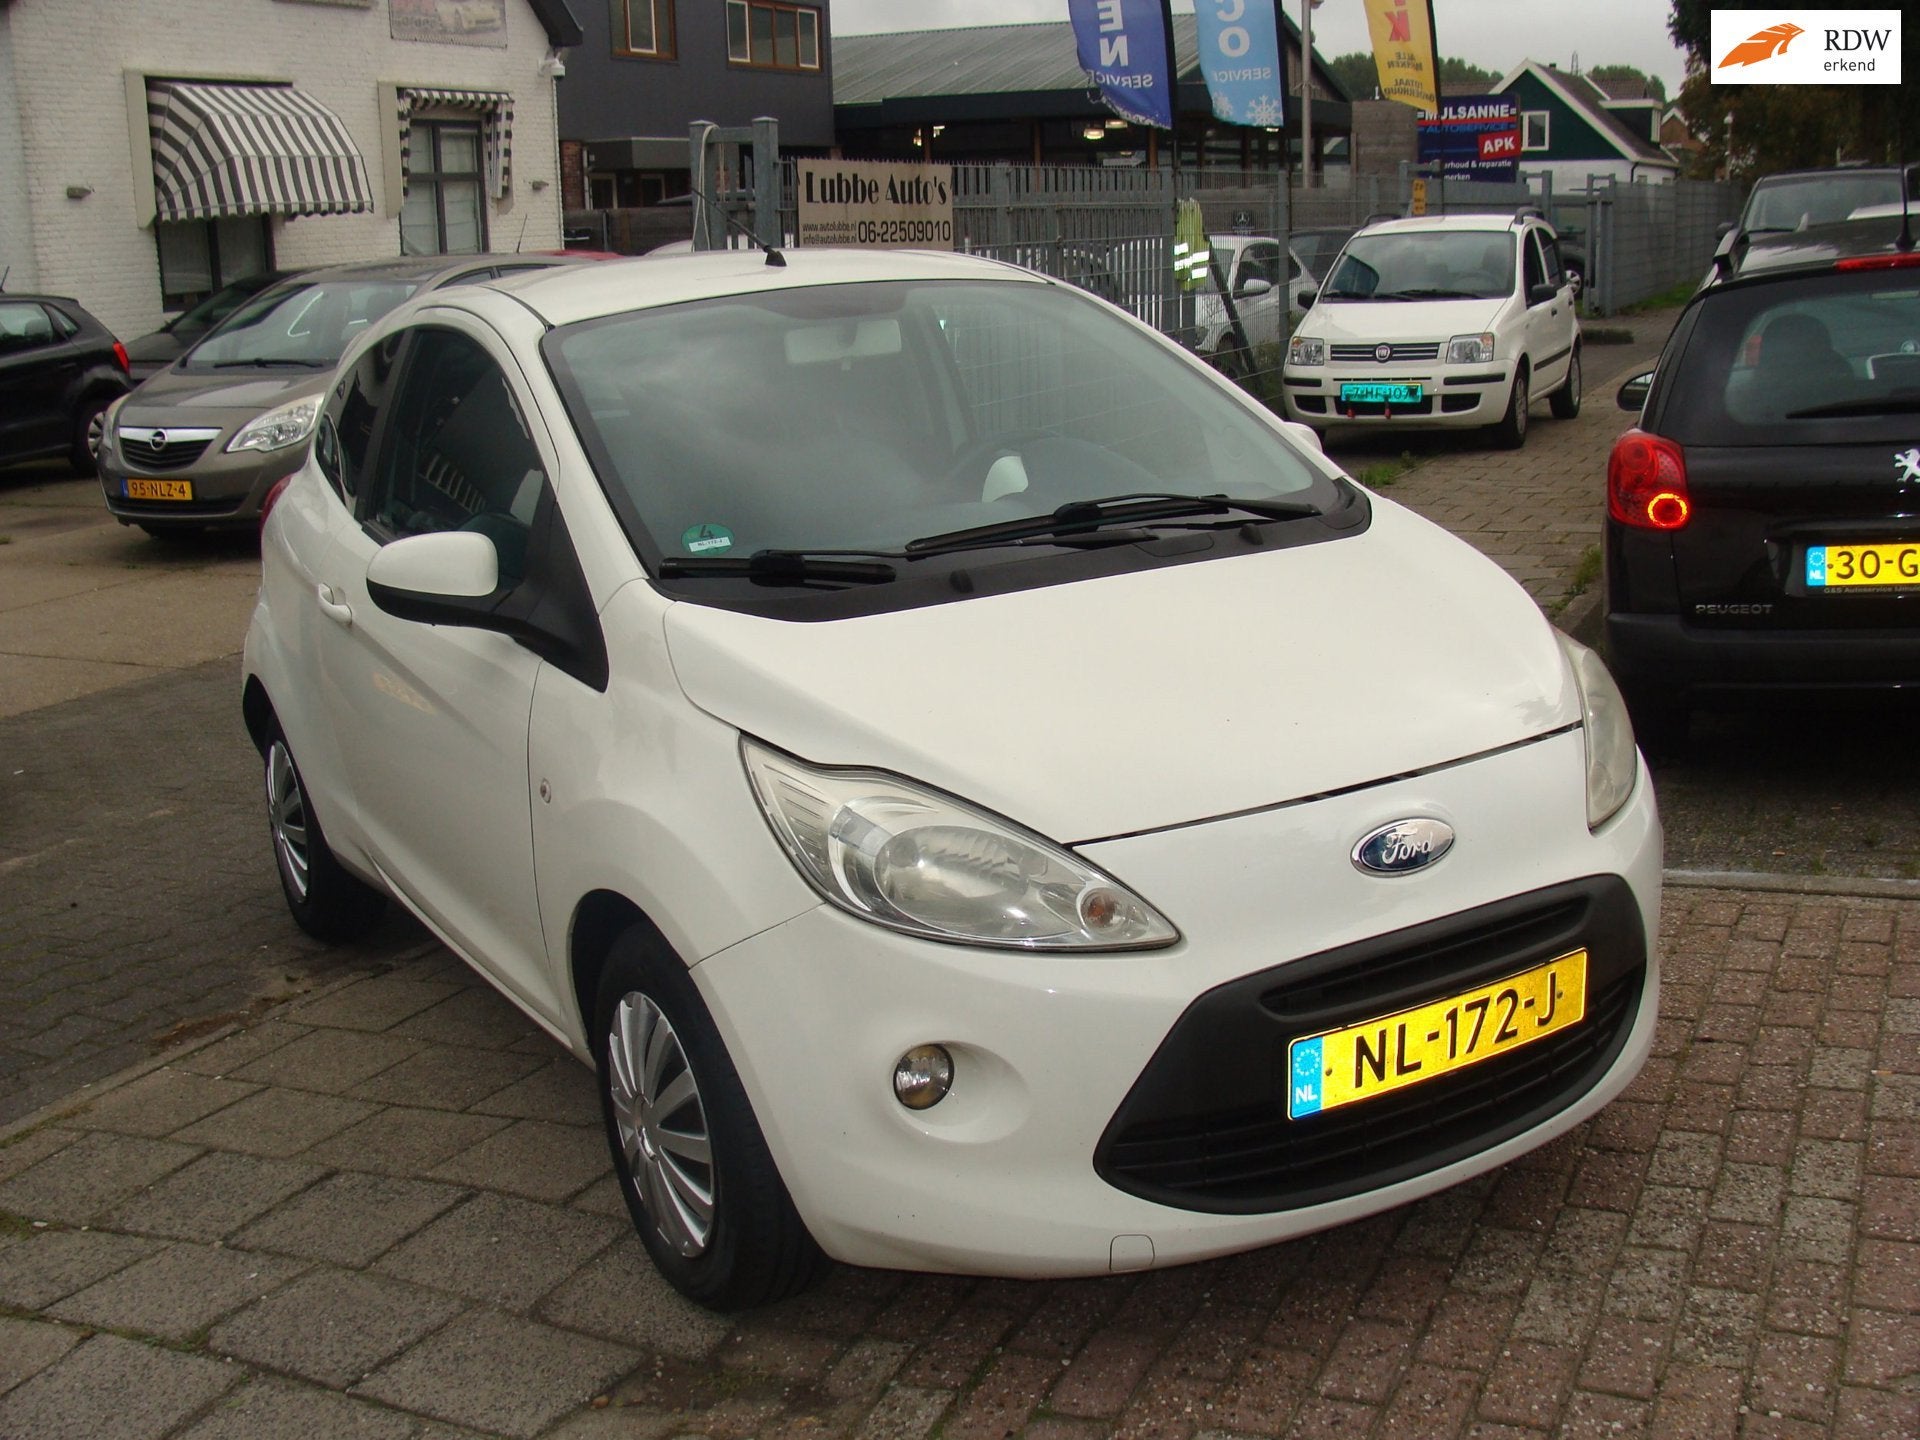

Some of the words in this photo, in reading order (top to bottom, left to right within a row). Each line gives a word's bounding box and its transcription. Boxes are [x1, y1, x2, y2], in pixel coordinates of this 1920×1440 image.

[1483, 136, 1516, 154] APK
[1478, 160, 1512, 170] reparatie
[805, 171, 879, 205] Lubbe
[885, 173, 947, 205] Auto's
[802, 220, 857, 232] www.autolubbe.nl
[858, 220, 951, 244] 06-22509010
[803, 233, 857, 246] info@autolubbe.nl
[131, 482, 187, 497] 95-NLZ-4
[1808, 569, 1824, 580] NL
[1695, 604, 1773, 615] PEUGEOT
[1382, 827, 1435, 866] Ford
[1354, 971, 1557, 1089] NL-172-J
[1295, 1086, 1318, 1105] NL
